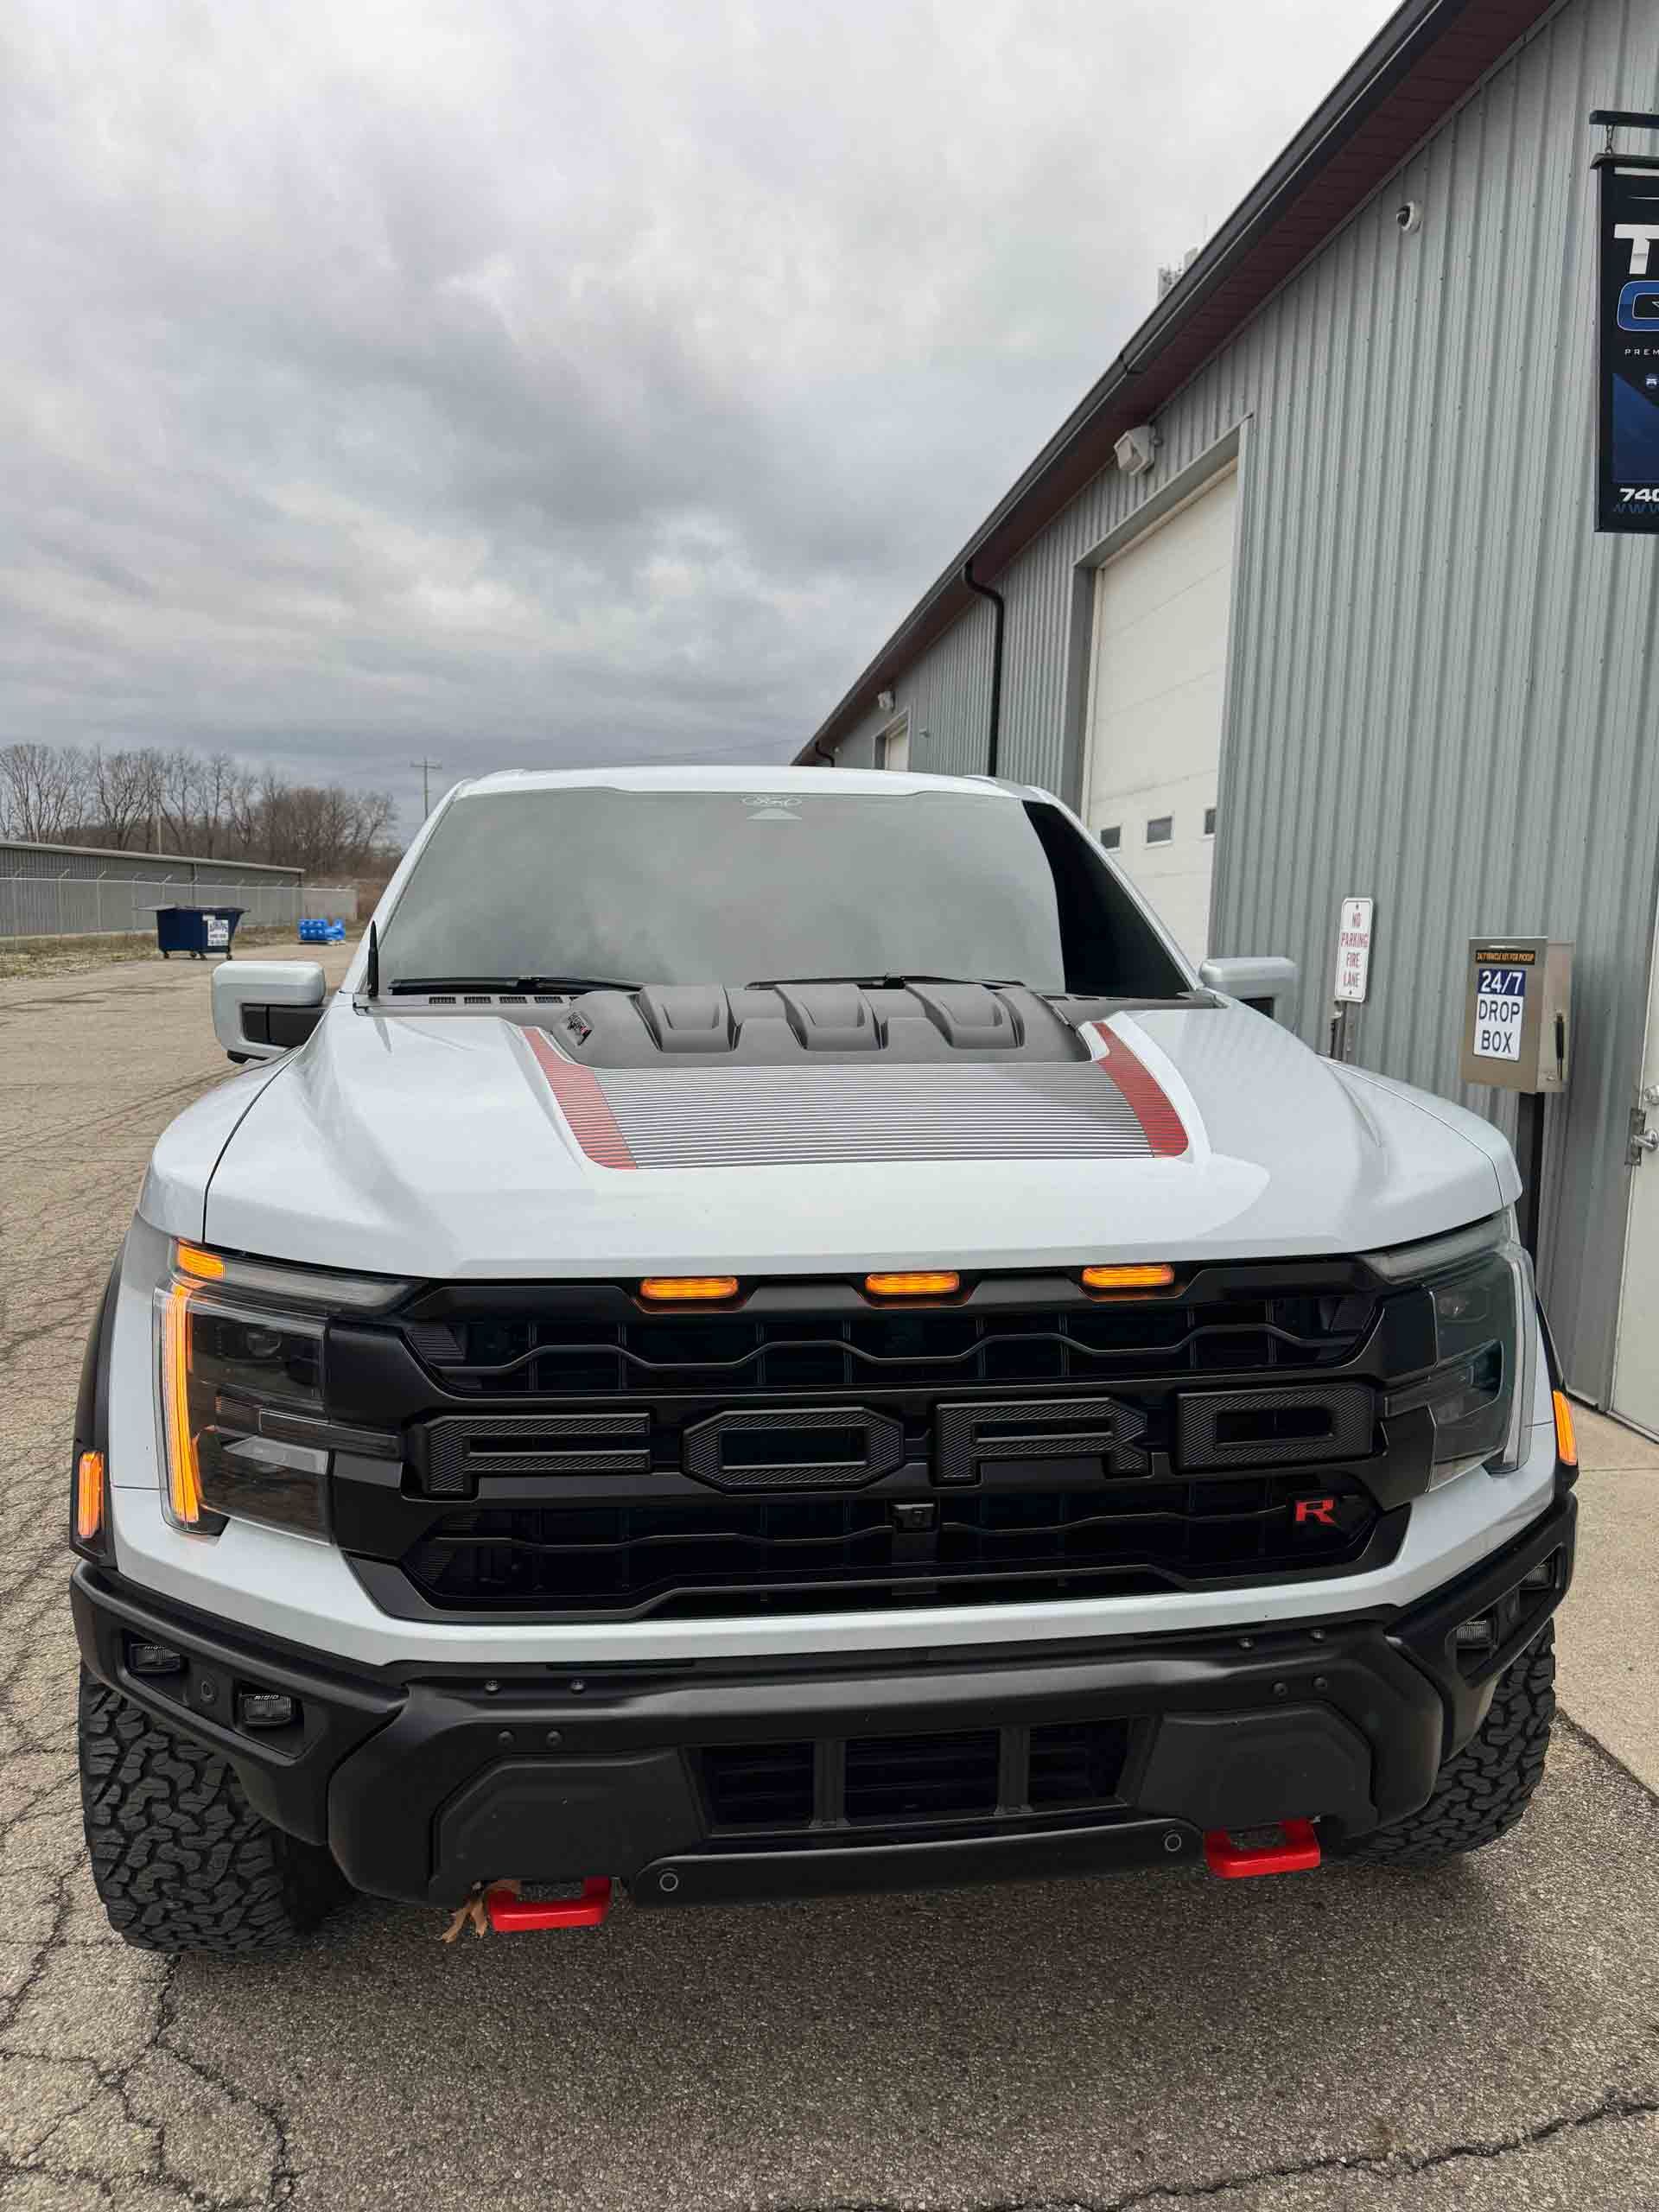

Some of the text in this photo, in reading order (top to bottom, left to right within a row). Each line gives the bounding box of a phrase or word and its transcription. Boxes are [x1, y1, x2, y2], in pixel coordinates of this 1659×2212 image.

[1352, 912, 1362, 927] NO
[1341, 933, 1369, 947] PARKING
[1347, 952, 1361, 968] FIRE
[1343, 970, 1360, 988] LANE
[1480, 969, 1523, 995] 24/7
[1478, 1000, 1521, 1023] DROP
[1481, 1030, 1513, 1053] BOX
[422, 1385, 1376, 1494] FORD
[1295, 1499, 1335, 1523] R
